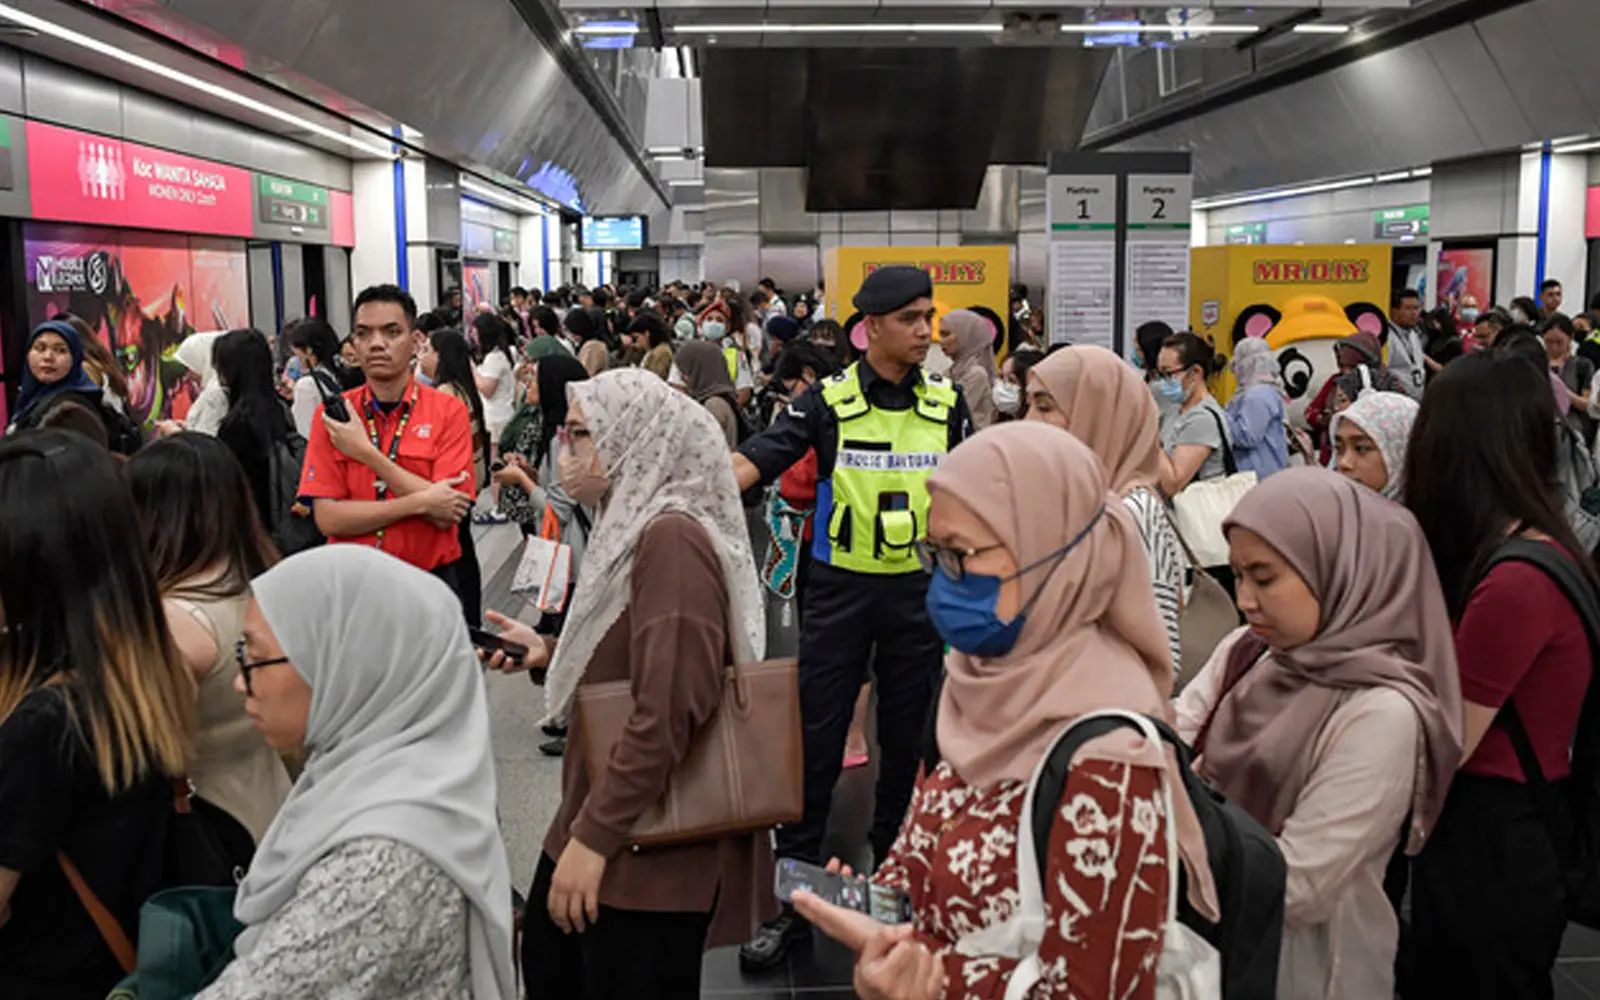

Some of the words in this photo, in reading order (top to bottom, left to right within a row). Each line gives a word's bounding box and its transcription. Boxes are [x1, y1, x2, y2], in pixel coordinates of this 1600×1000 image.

[1066, 186, 1099, 194] Platform
[1142, 186, 1175, 194] Platform
[1077, 200, 1090, 219] 1
[1152, 198, 1165, 219] 2
